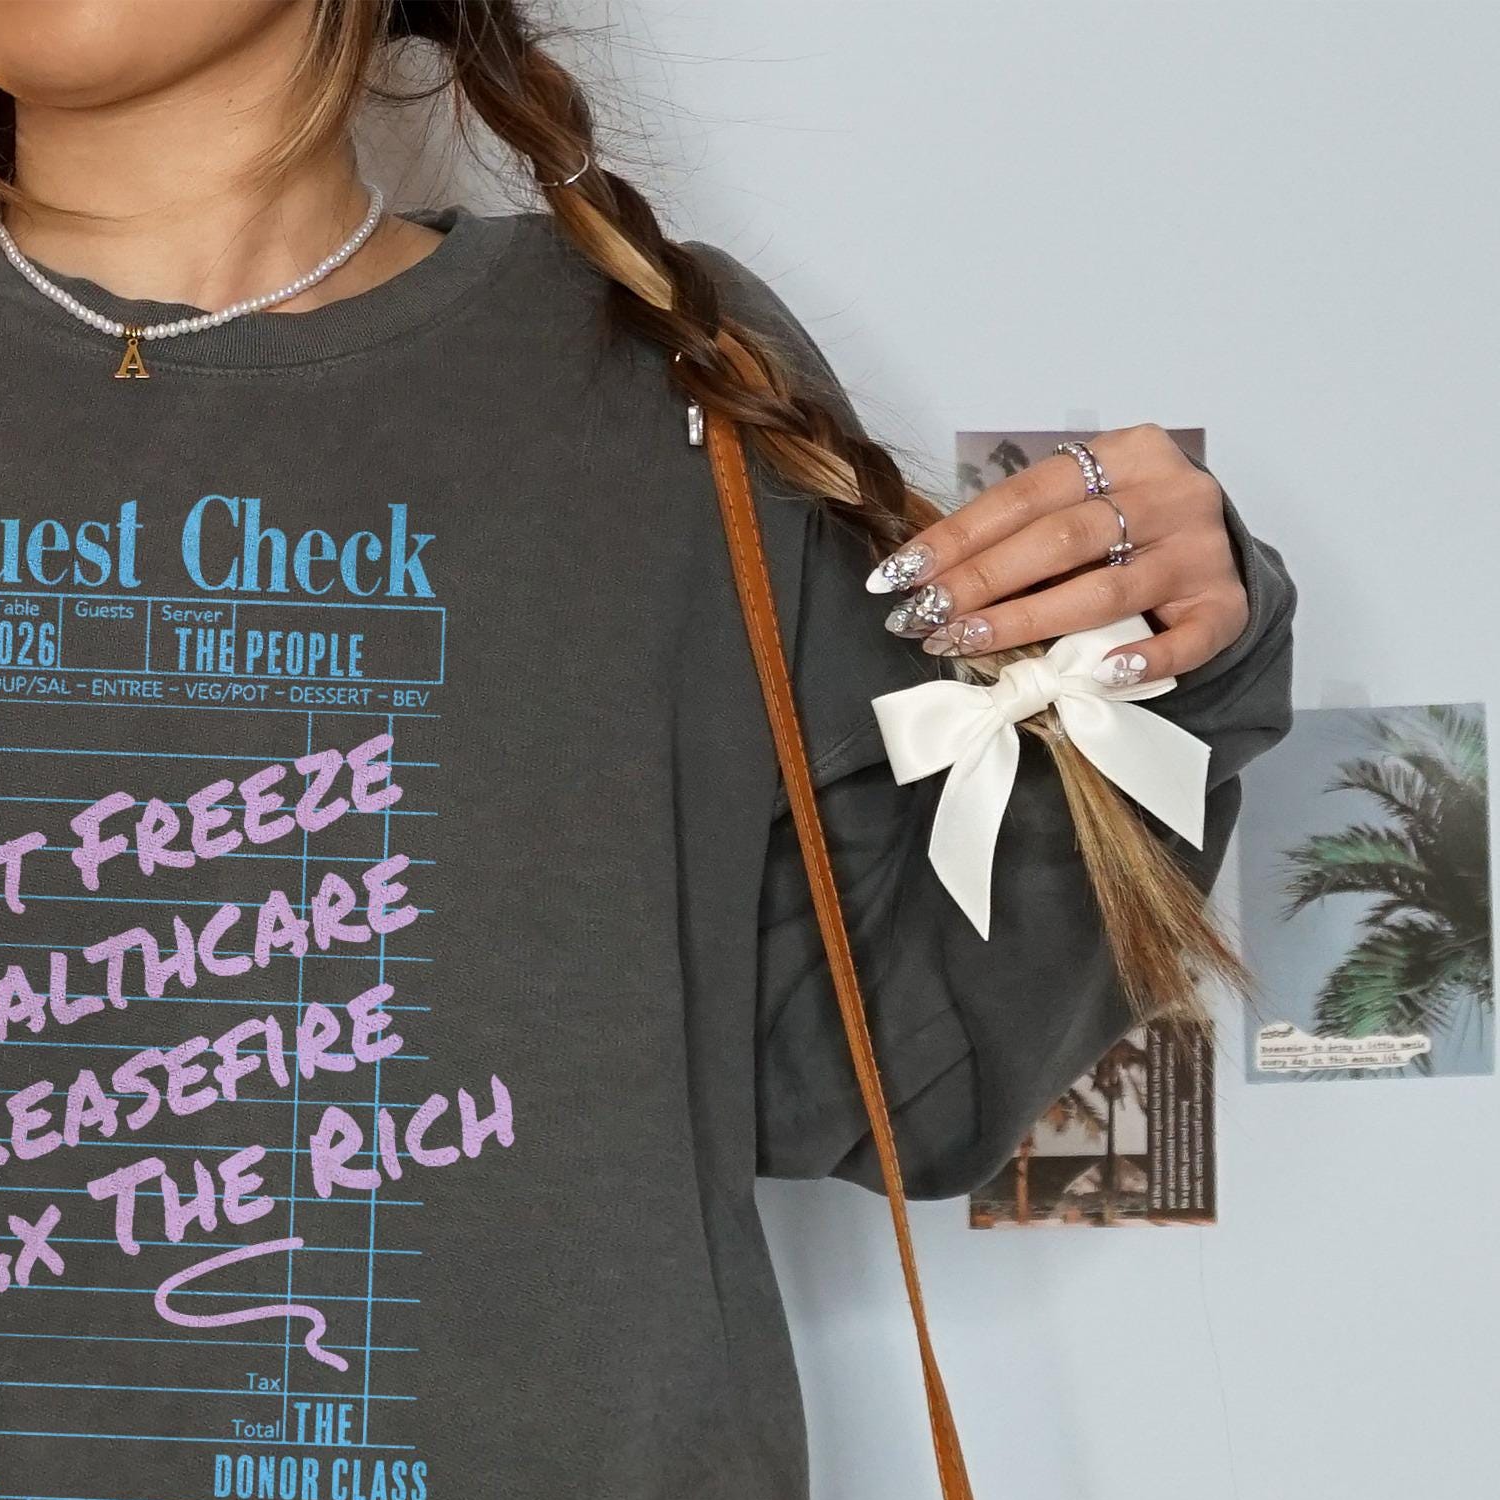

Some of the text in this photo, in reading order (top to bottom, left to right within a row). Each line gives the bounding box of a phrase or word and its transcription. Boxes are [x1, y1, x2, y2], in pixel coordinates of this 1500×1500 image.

[181, 495, 436, 598] Check
[74, 600, 135, 620] Guests
[161, 604, 224, 623] Server
[174, 627, 365, 678] THE PEOPLE
[91, 678, 165, 699] ENTREE
[184, 681, 270, 703] VEG/POT
[289, 685, 373, 706] DESSERT
[392, 689, 431, 707] BEV
[70, 733, 404, 890] FREEZE
[87, 1145, 274, 1255] THE
[310, 1074, 515, 1198] RICH
[245, 1373, 281, 1391] Tax
[231, 1402, 353, 1446] Total THE
[213, 1453, 320, 1500] DONOR
